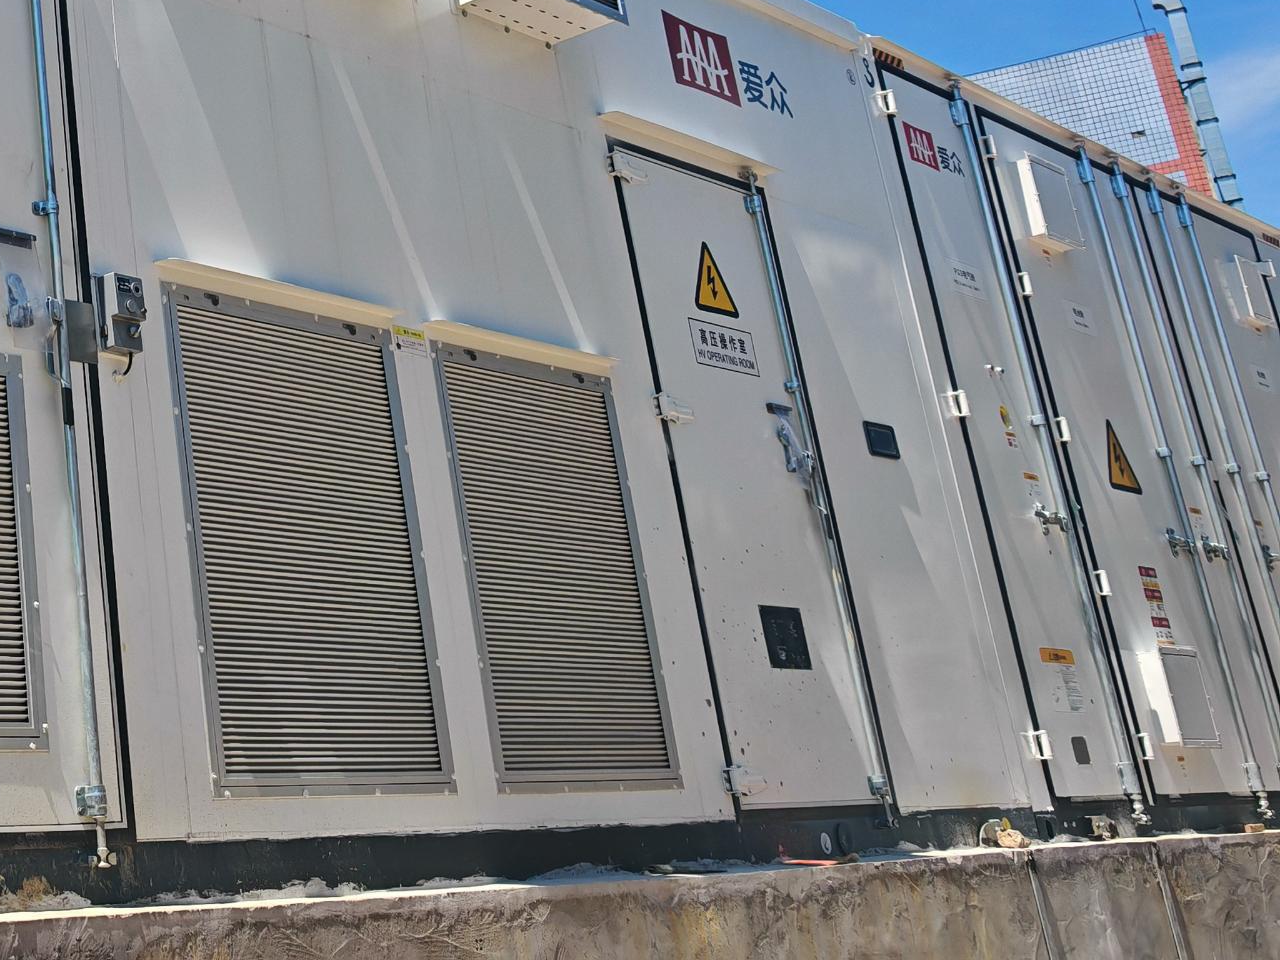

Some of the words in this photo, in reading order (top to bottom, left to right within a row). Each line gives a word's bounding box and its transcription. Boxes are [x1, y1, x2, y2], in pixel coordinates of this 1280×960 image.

[737, 60, 794, 119] 爱众
[936, 145, 966, 178] 爱众
[698, 328, 748, 355] 高压操作室
[706, 350, 738, 367] OPERATING
[738, 357, 755, 370] ROOM
